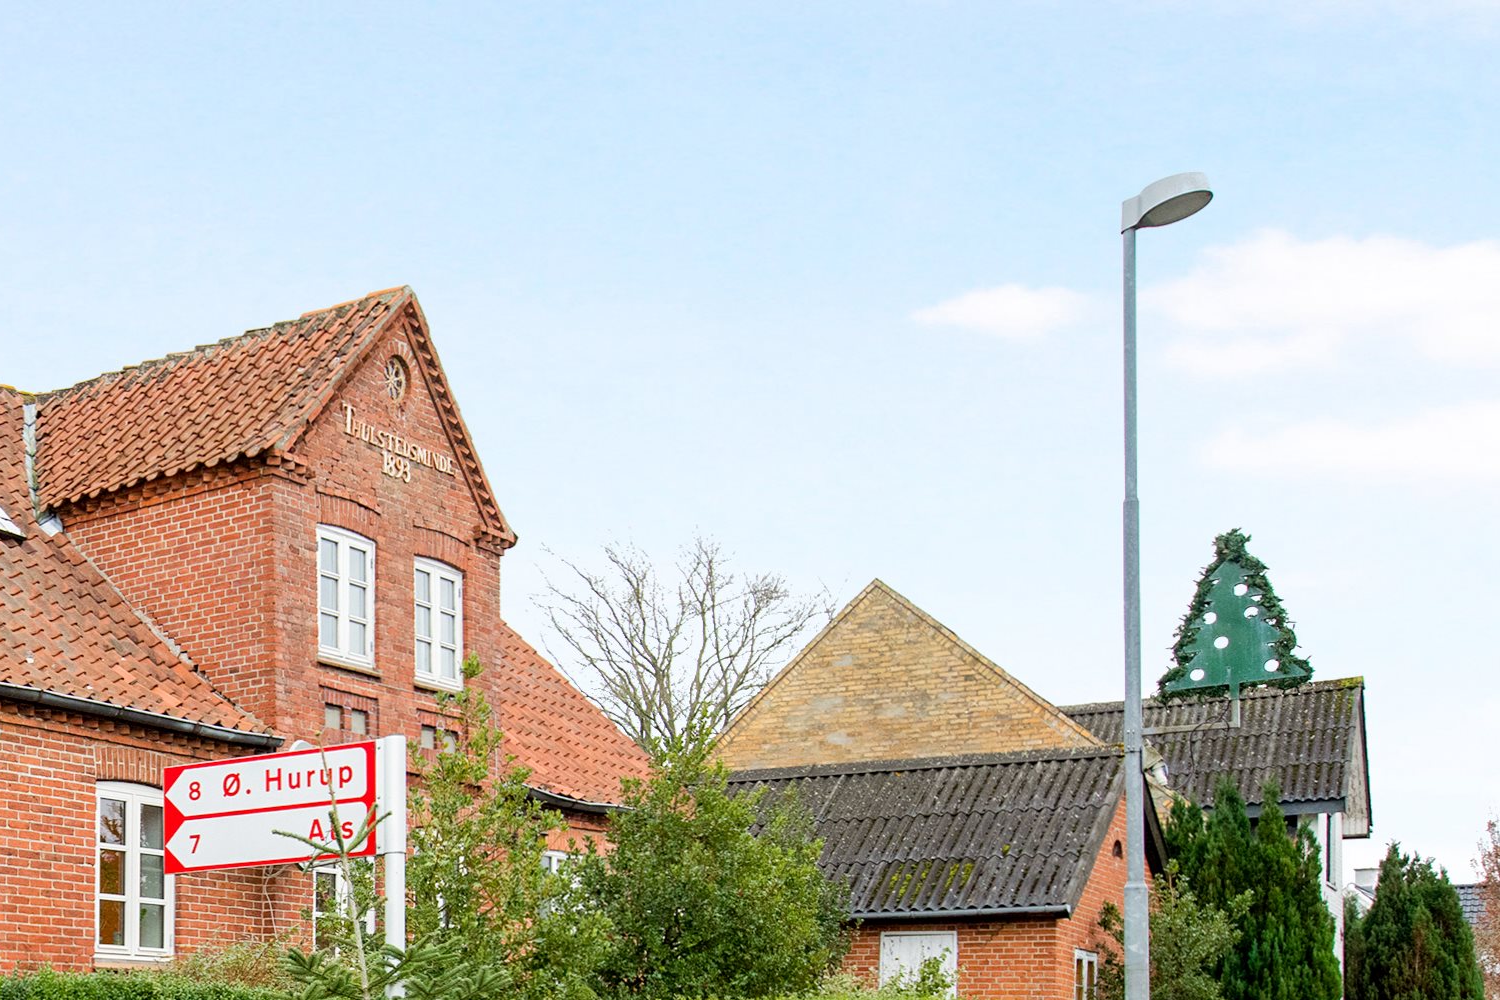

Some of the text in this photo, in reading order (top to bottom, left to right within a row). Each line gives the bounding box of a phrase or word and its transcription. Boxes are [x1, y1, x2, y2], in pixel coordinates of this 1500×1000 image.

[382, 451, 411, 483] 1893
[188, 765, 353, 800] 8 Ø. Hurup
[189, 835, 201, 853] 7
